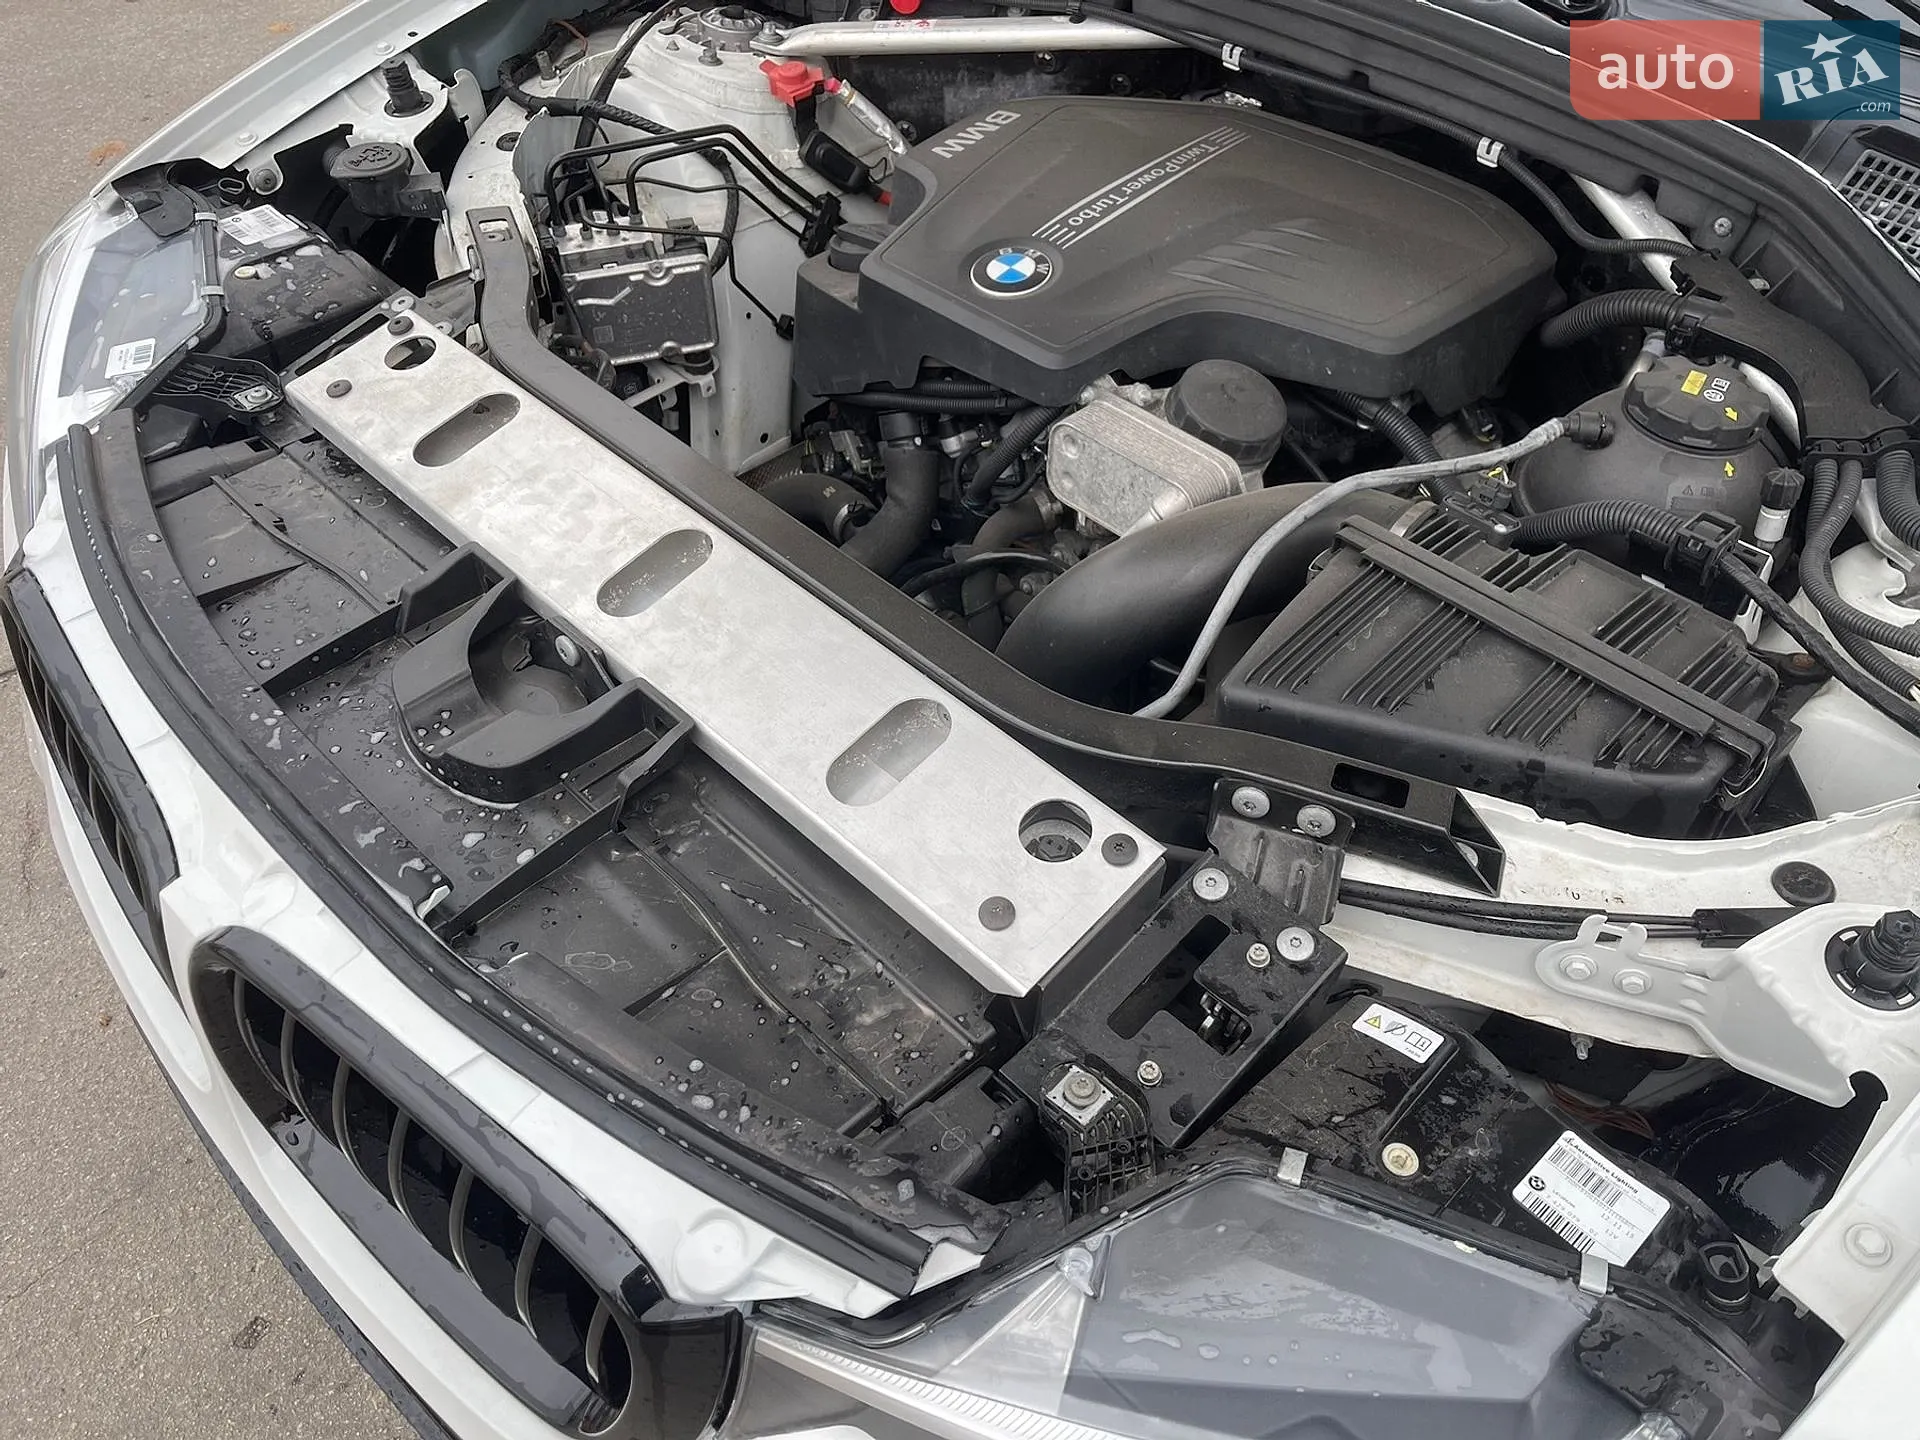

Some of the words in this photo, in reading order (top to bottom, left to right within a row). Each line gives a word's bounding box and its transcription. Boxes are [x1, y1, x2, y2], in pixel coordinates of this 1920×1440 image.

[931, 109, 1022, 159] BMW
[1574, 1144, 1611, 1174] Automotive
[1610, 1171, 1639, 1195] Lighting
